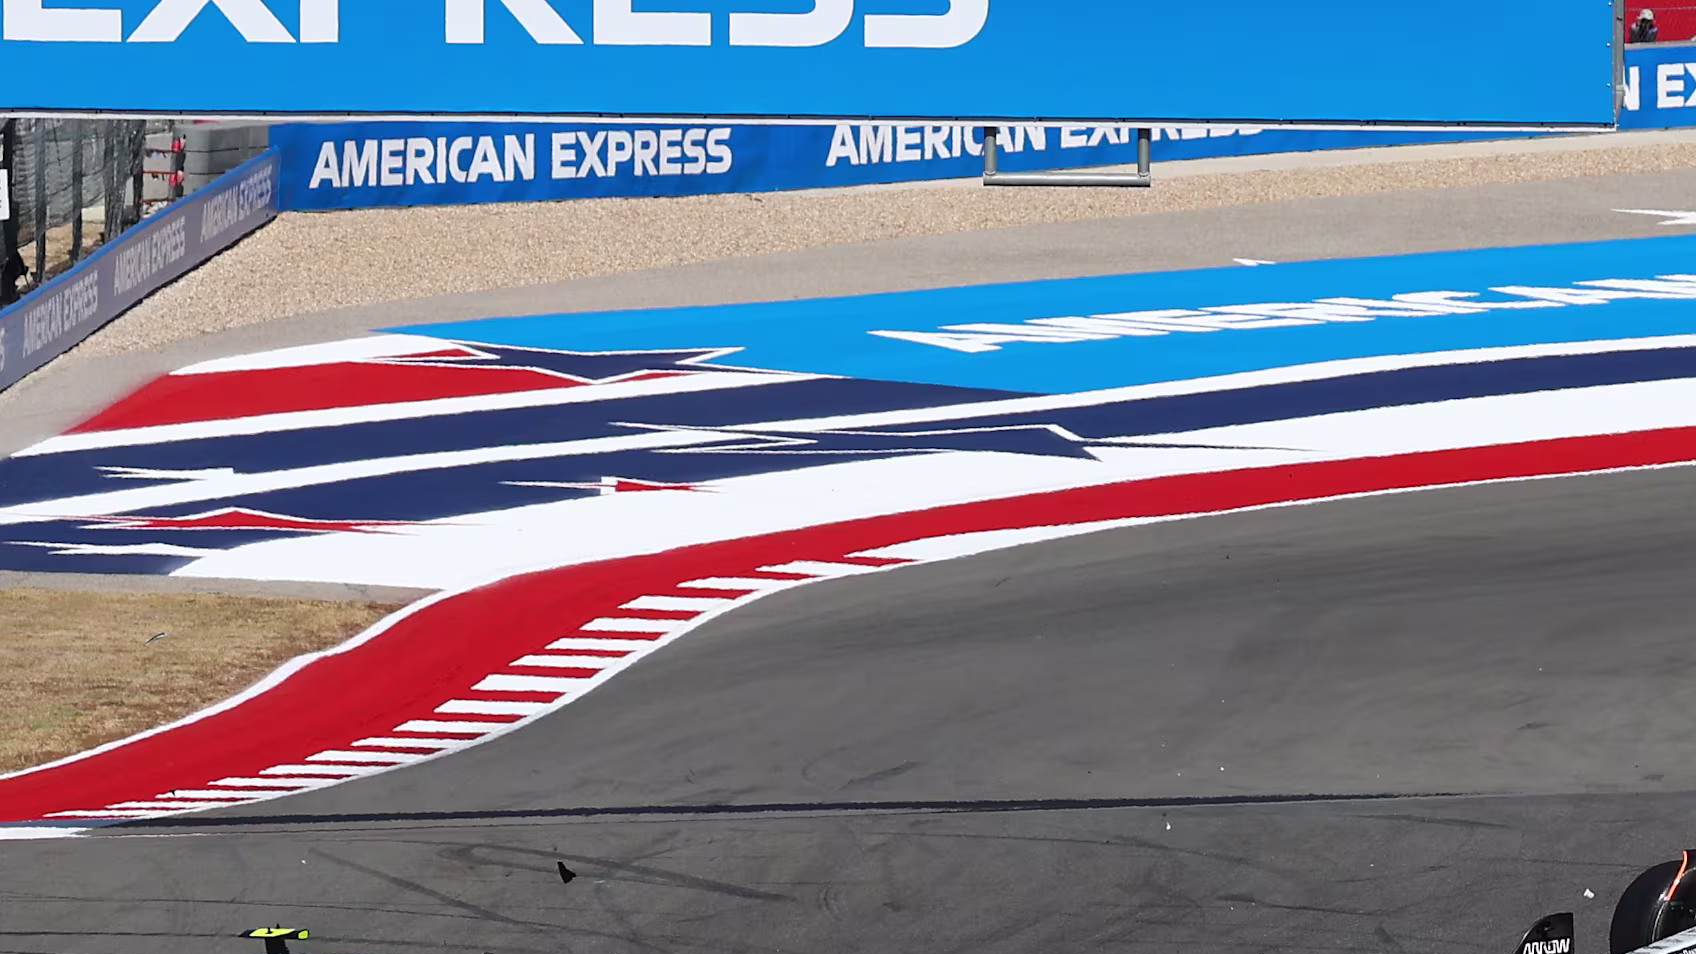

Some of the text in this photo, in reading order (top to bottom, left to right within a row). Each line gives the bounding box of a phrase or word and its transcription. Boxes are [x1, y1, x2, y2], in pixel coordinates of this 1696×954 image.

[309, 126, 733, 190] AMERICAN EXPRESS
[201, 165, 273, 243] AMERICAN EXPRESS
[114, 217, 186, 296] AMERICAN EXPRESS
[23, 290, 62, 358] AMERICAN
[62, 270, 98, 333] EXPRESS
